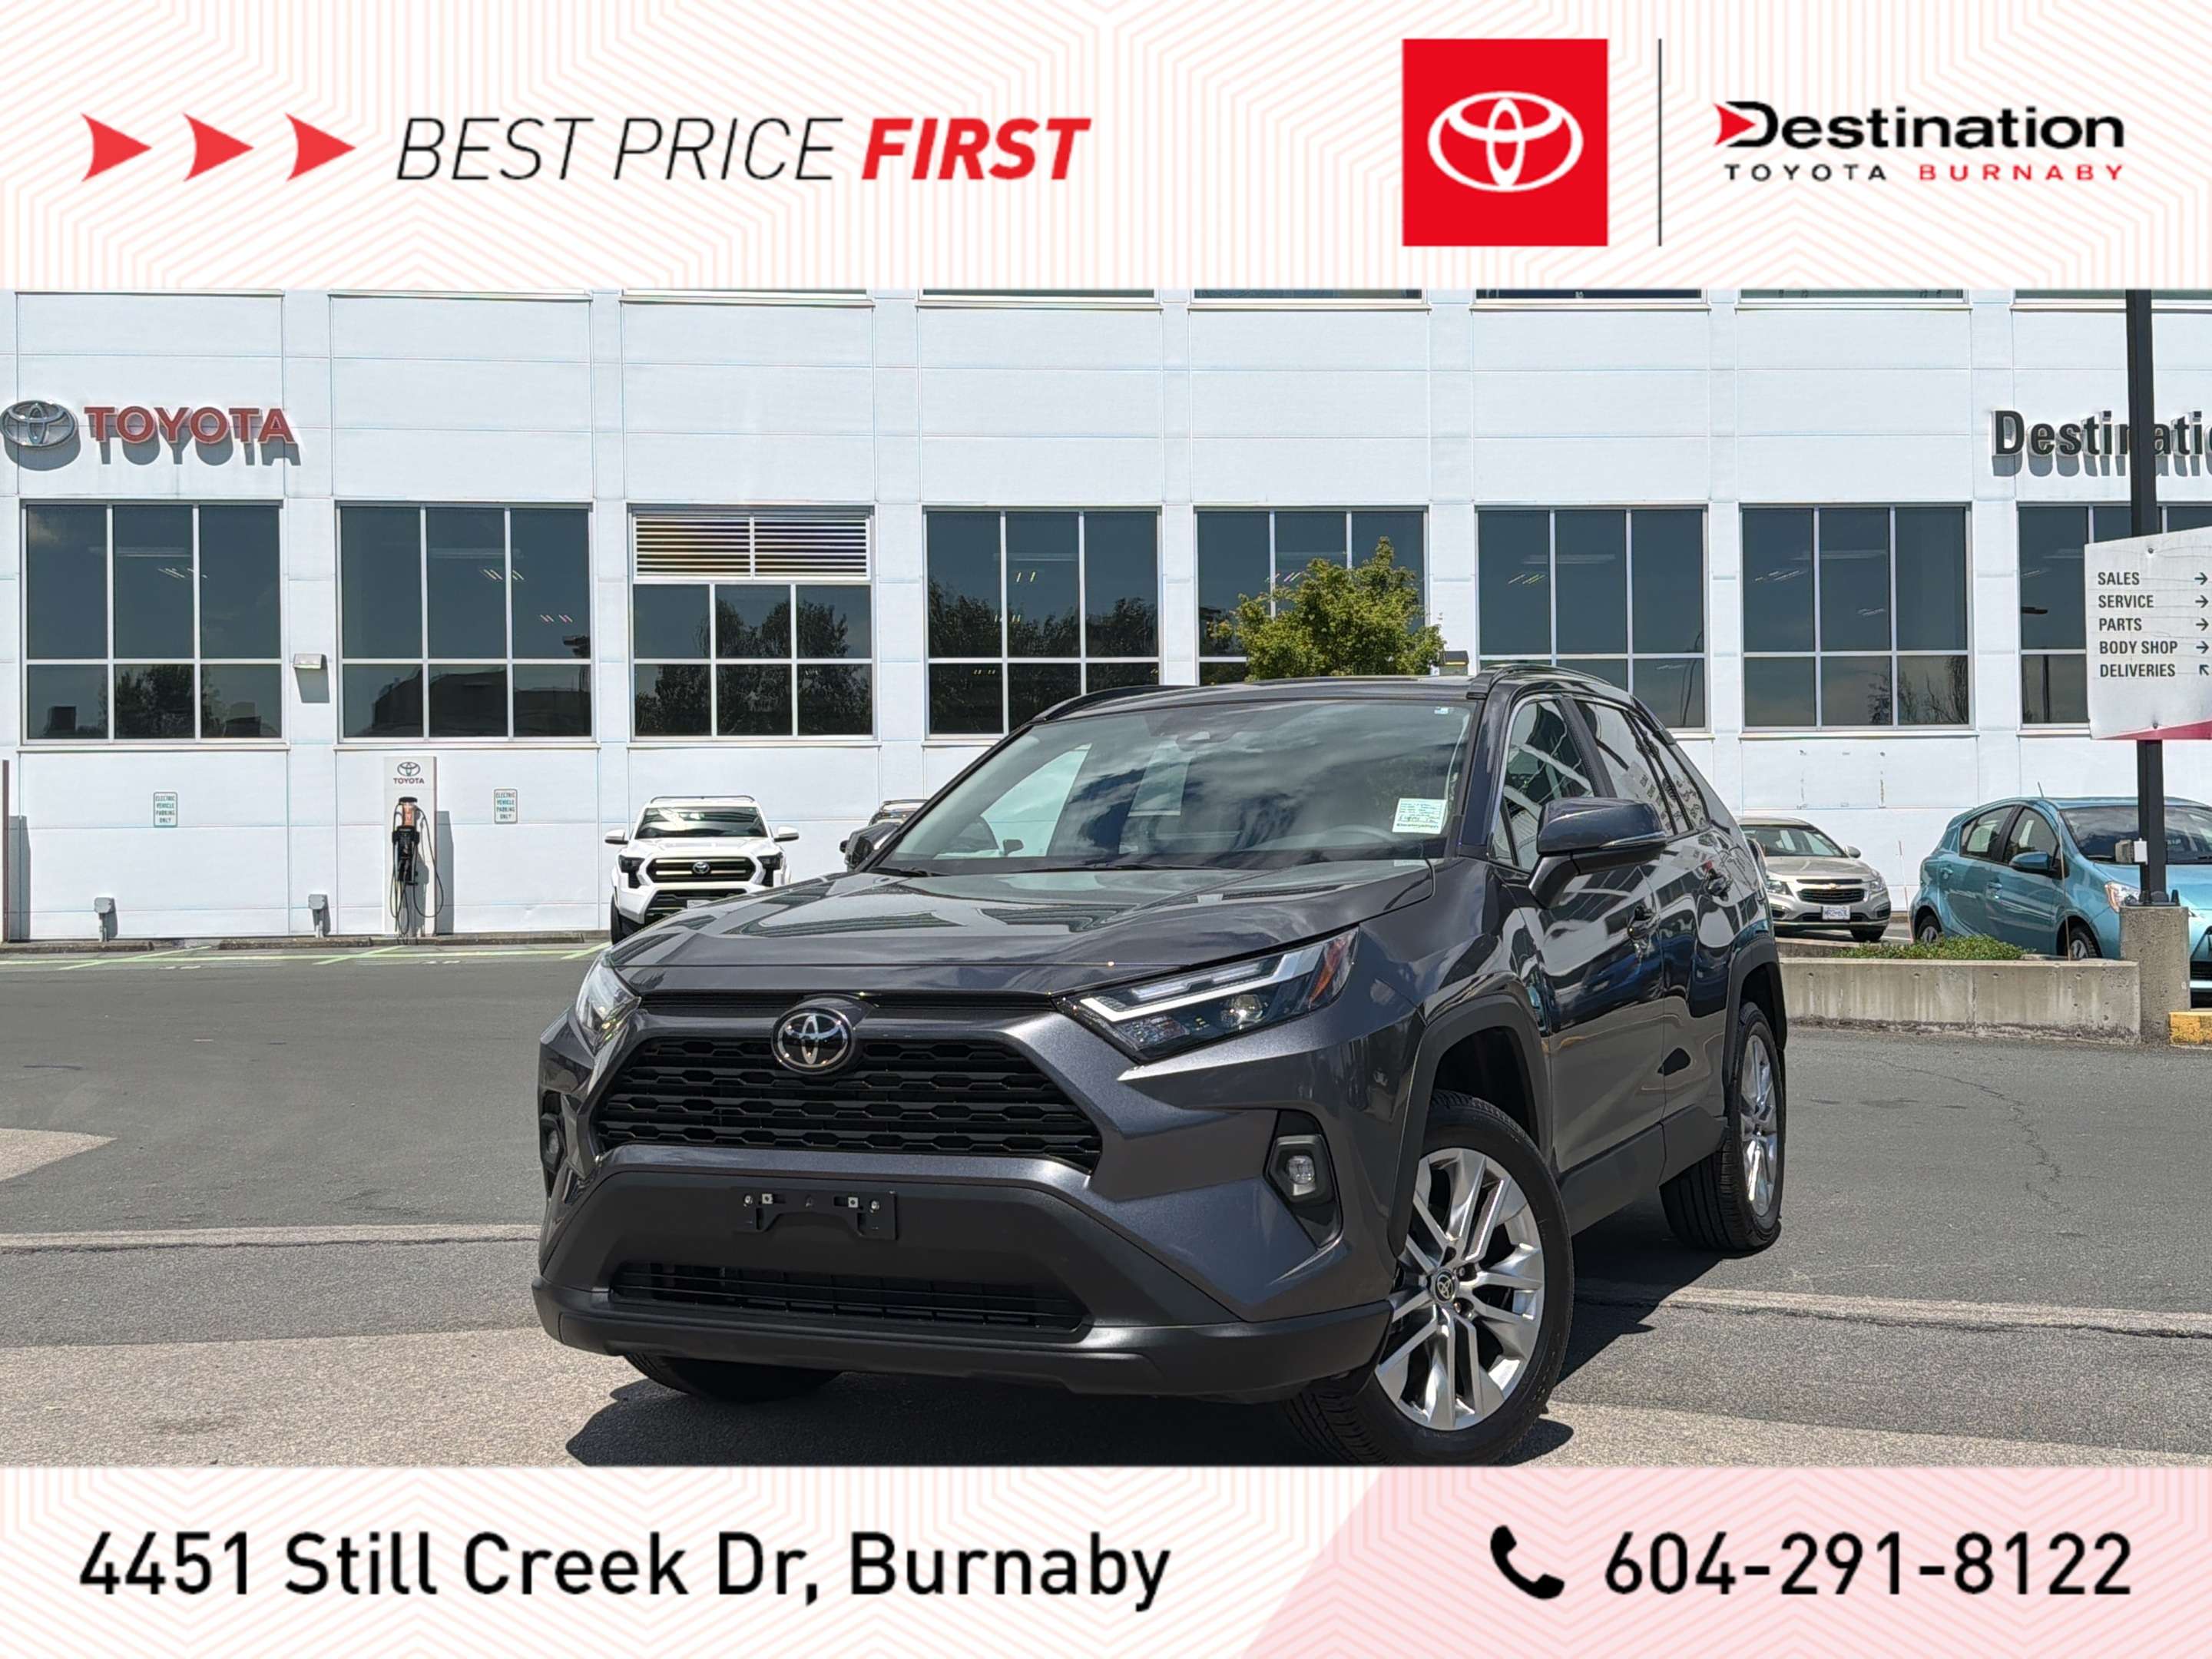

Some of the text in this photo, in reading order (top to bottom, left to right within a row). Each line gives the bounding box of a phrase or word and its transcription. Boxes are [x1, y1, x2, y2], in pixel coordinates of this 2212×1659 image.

[84, 406, 295, 444] TOYOTA
[1994, 409, 2212, 455] Destiati
[2098, 571, 2140, 586] SALES
[2098, 594, 2154, 609] SERVICE
[2099, 618, 2142, 632] PARTS
[2099, 641, 2178, 654] BODY SHOP
[2100, 663, 2176, 677] DELIVERIES
